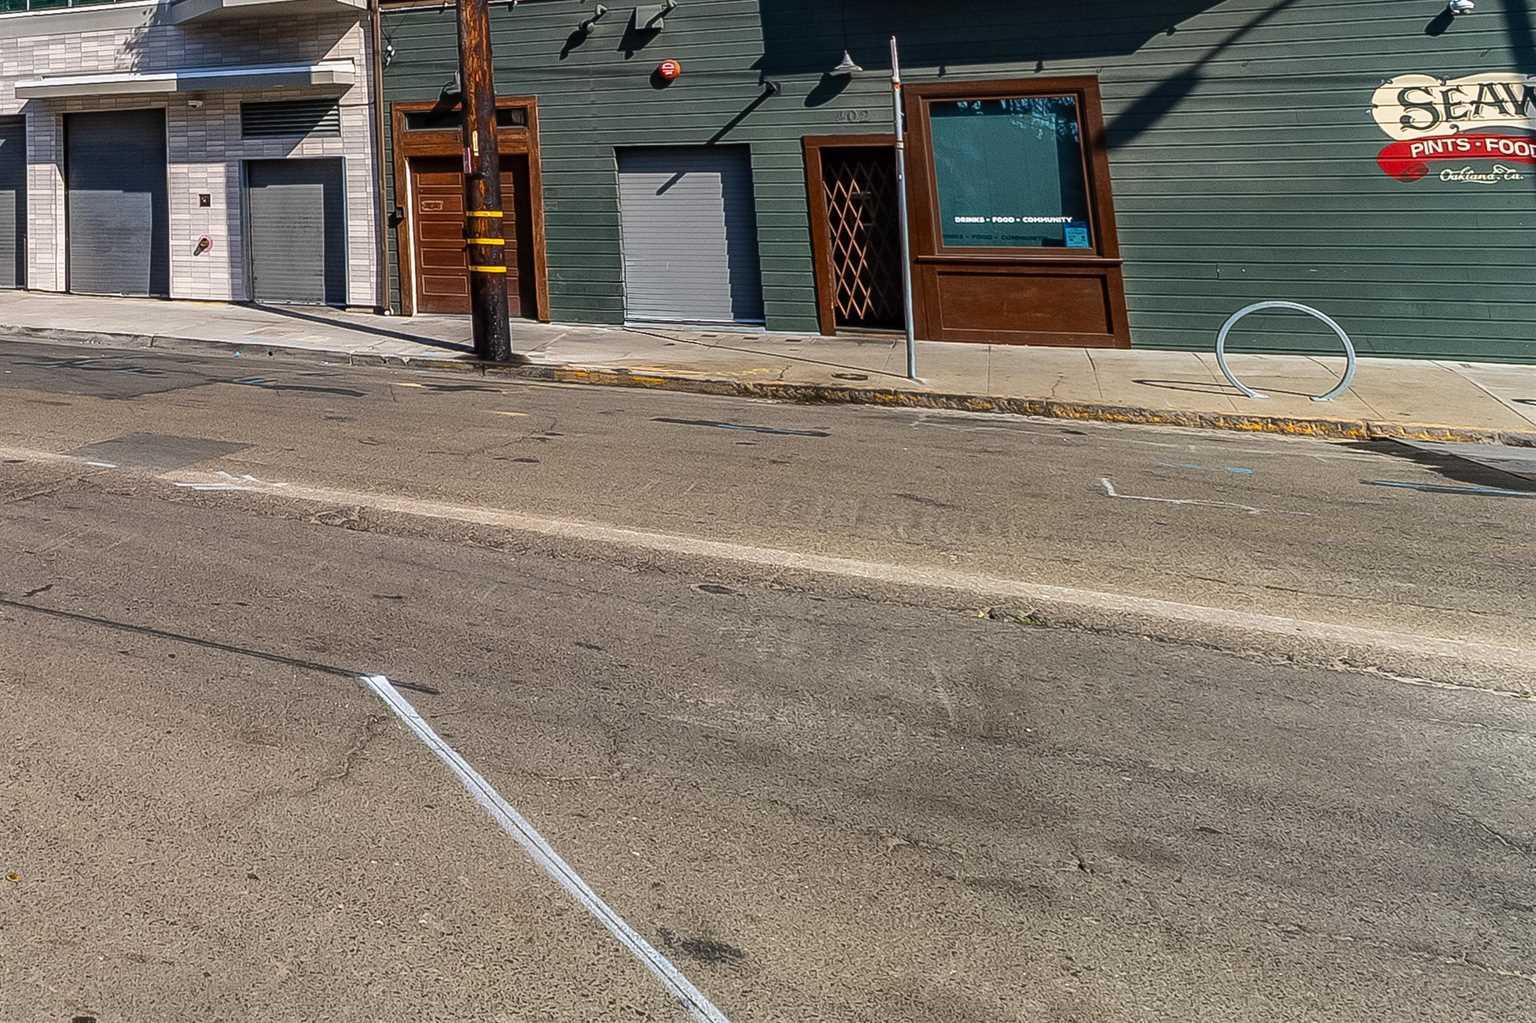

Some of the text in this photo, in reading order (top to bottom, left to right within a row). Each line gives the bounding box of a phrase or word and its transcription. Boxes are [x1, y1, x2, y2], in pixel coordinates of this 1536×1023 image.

[1410, 138, 1471, 158] PINTS
[954, 216, 1073, 224] DRINKS FOOD COMMUNITY
